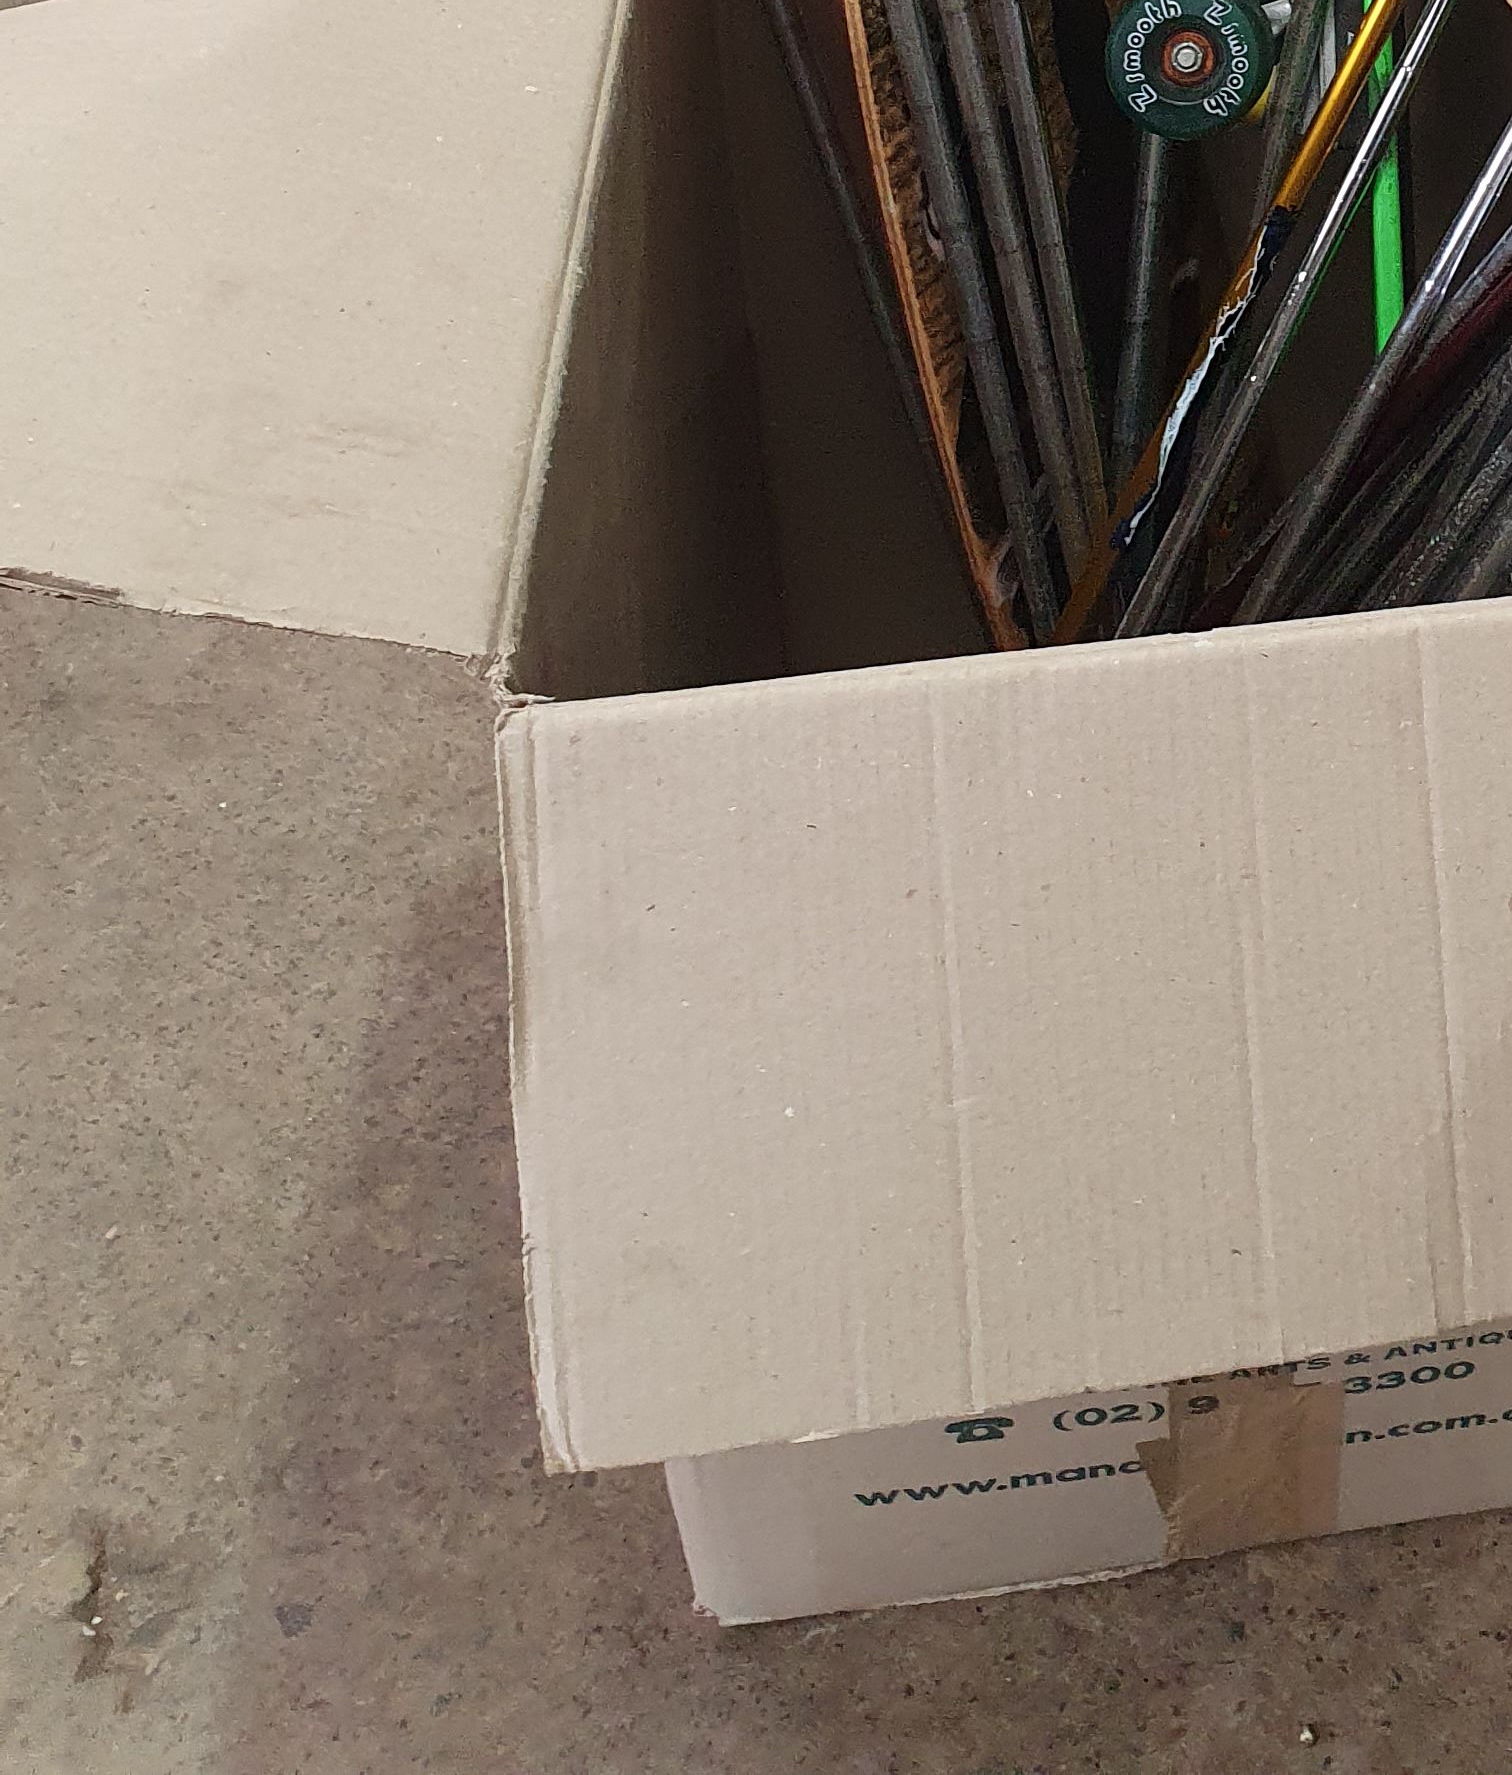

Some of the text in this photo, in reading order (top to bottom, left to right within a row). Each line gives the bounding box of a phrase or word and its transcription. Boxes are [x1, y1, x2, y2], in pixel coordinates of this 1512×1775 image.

[1343, 1352, 1371, 1365] &
[1053, 1401, 1166, 1432] (02)
[1343, 1361, 1476, 1395] 3300
